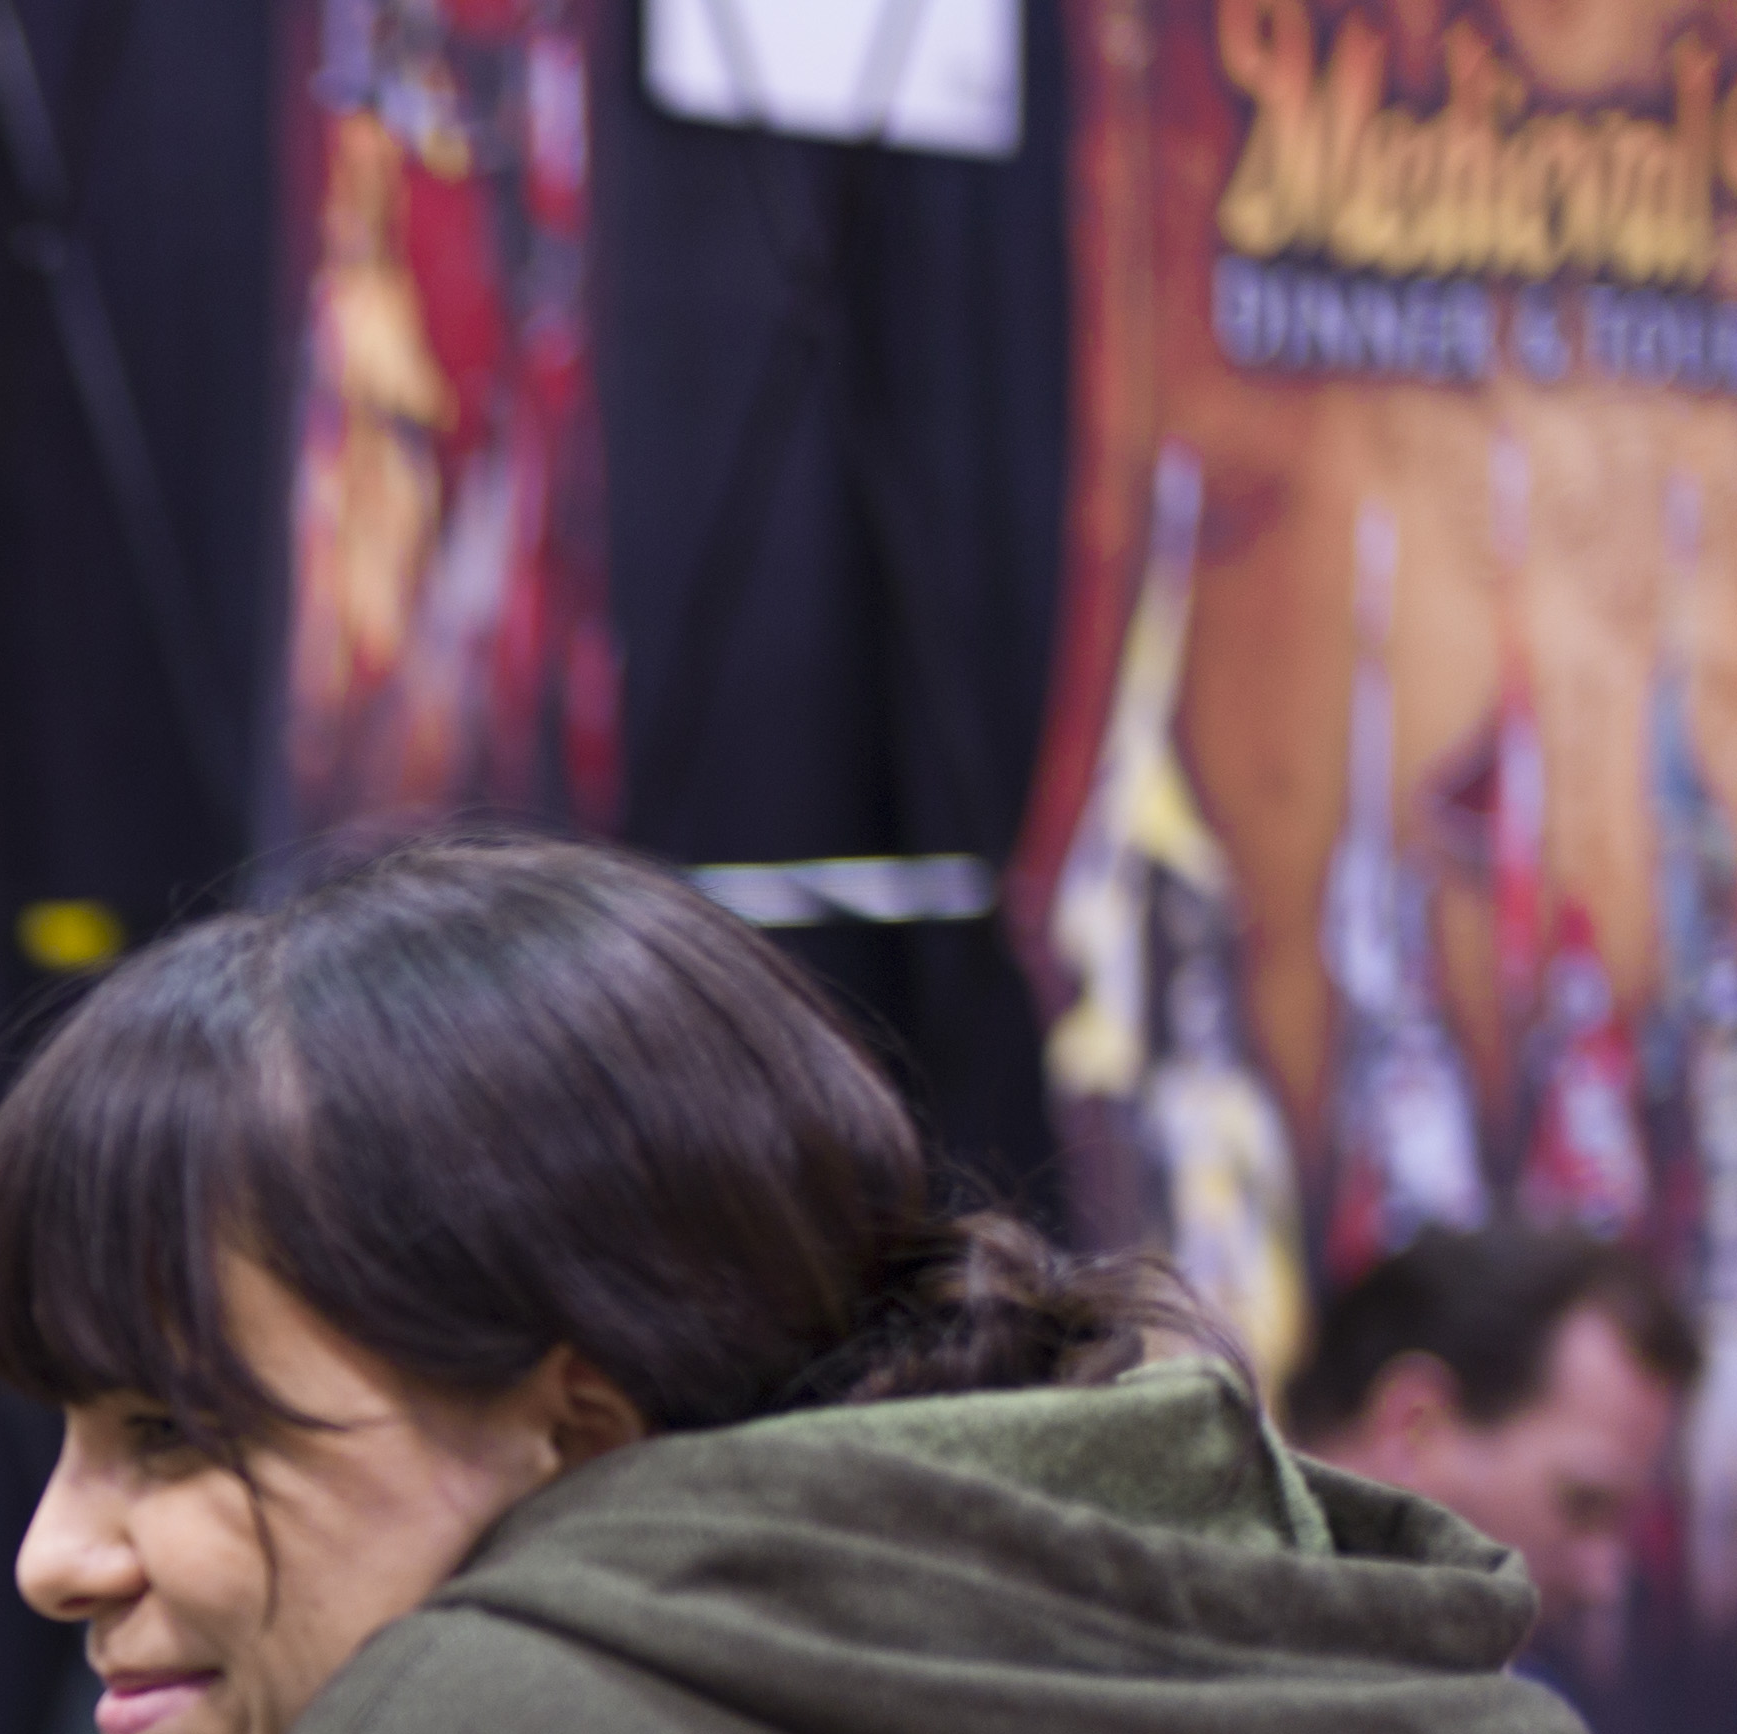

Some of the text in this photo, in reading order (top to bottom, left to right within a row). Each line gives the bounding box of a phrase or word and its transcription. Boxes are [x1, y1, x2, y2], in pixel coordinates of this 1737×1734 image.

[1215, 0, 1717, 288] Medieval
[1211, 252, 1493, 384] DINNER
[1513, 280, 1571, 386] &
